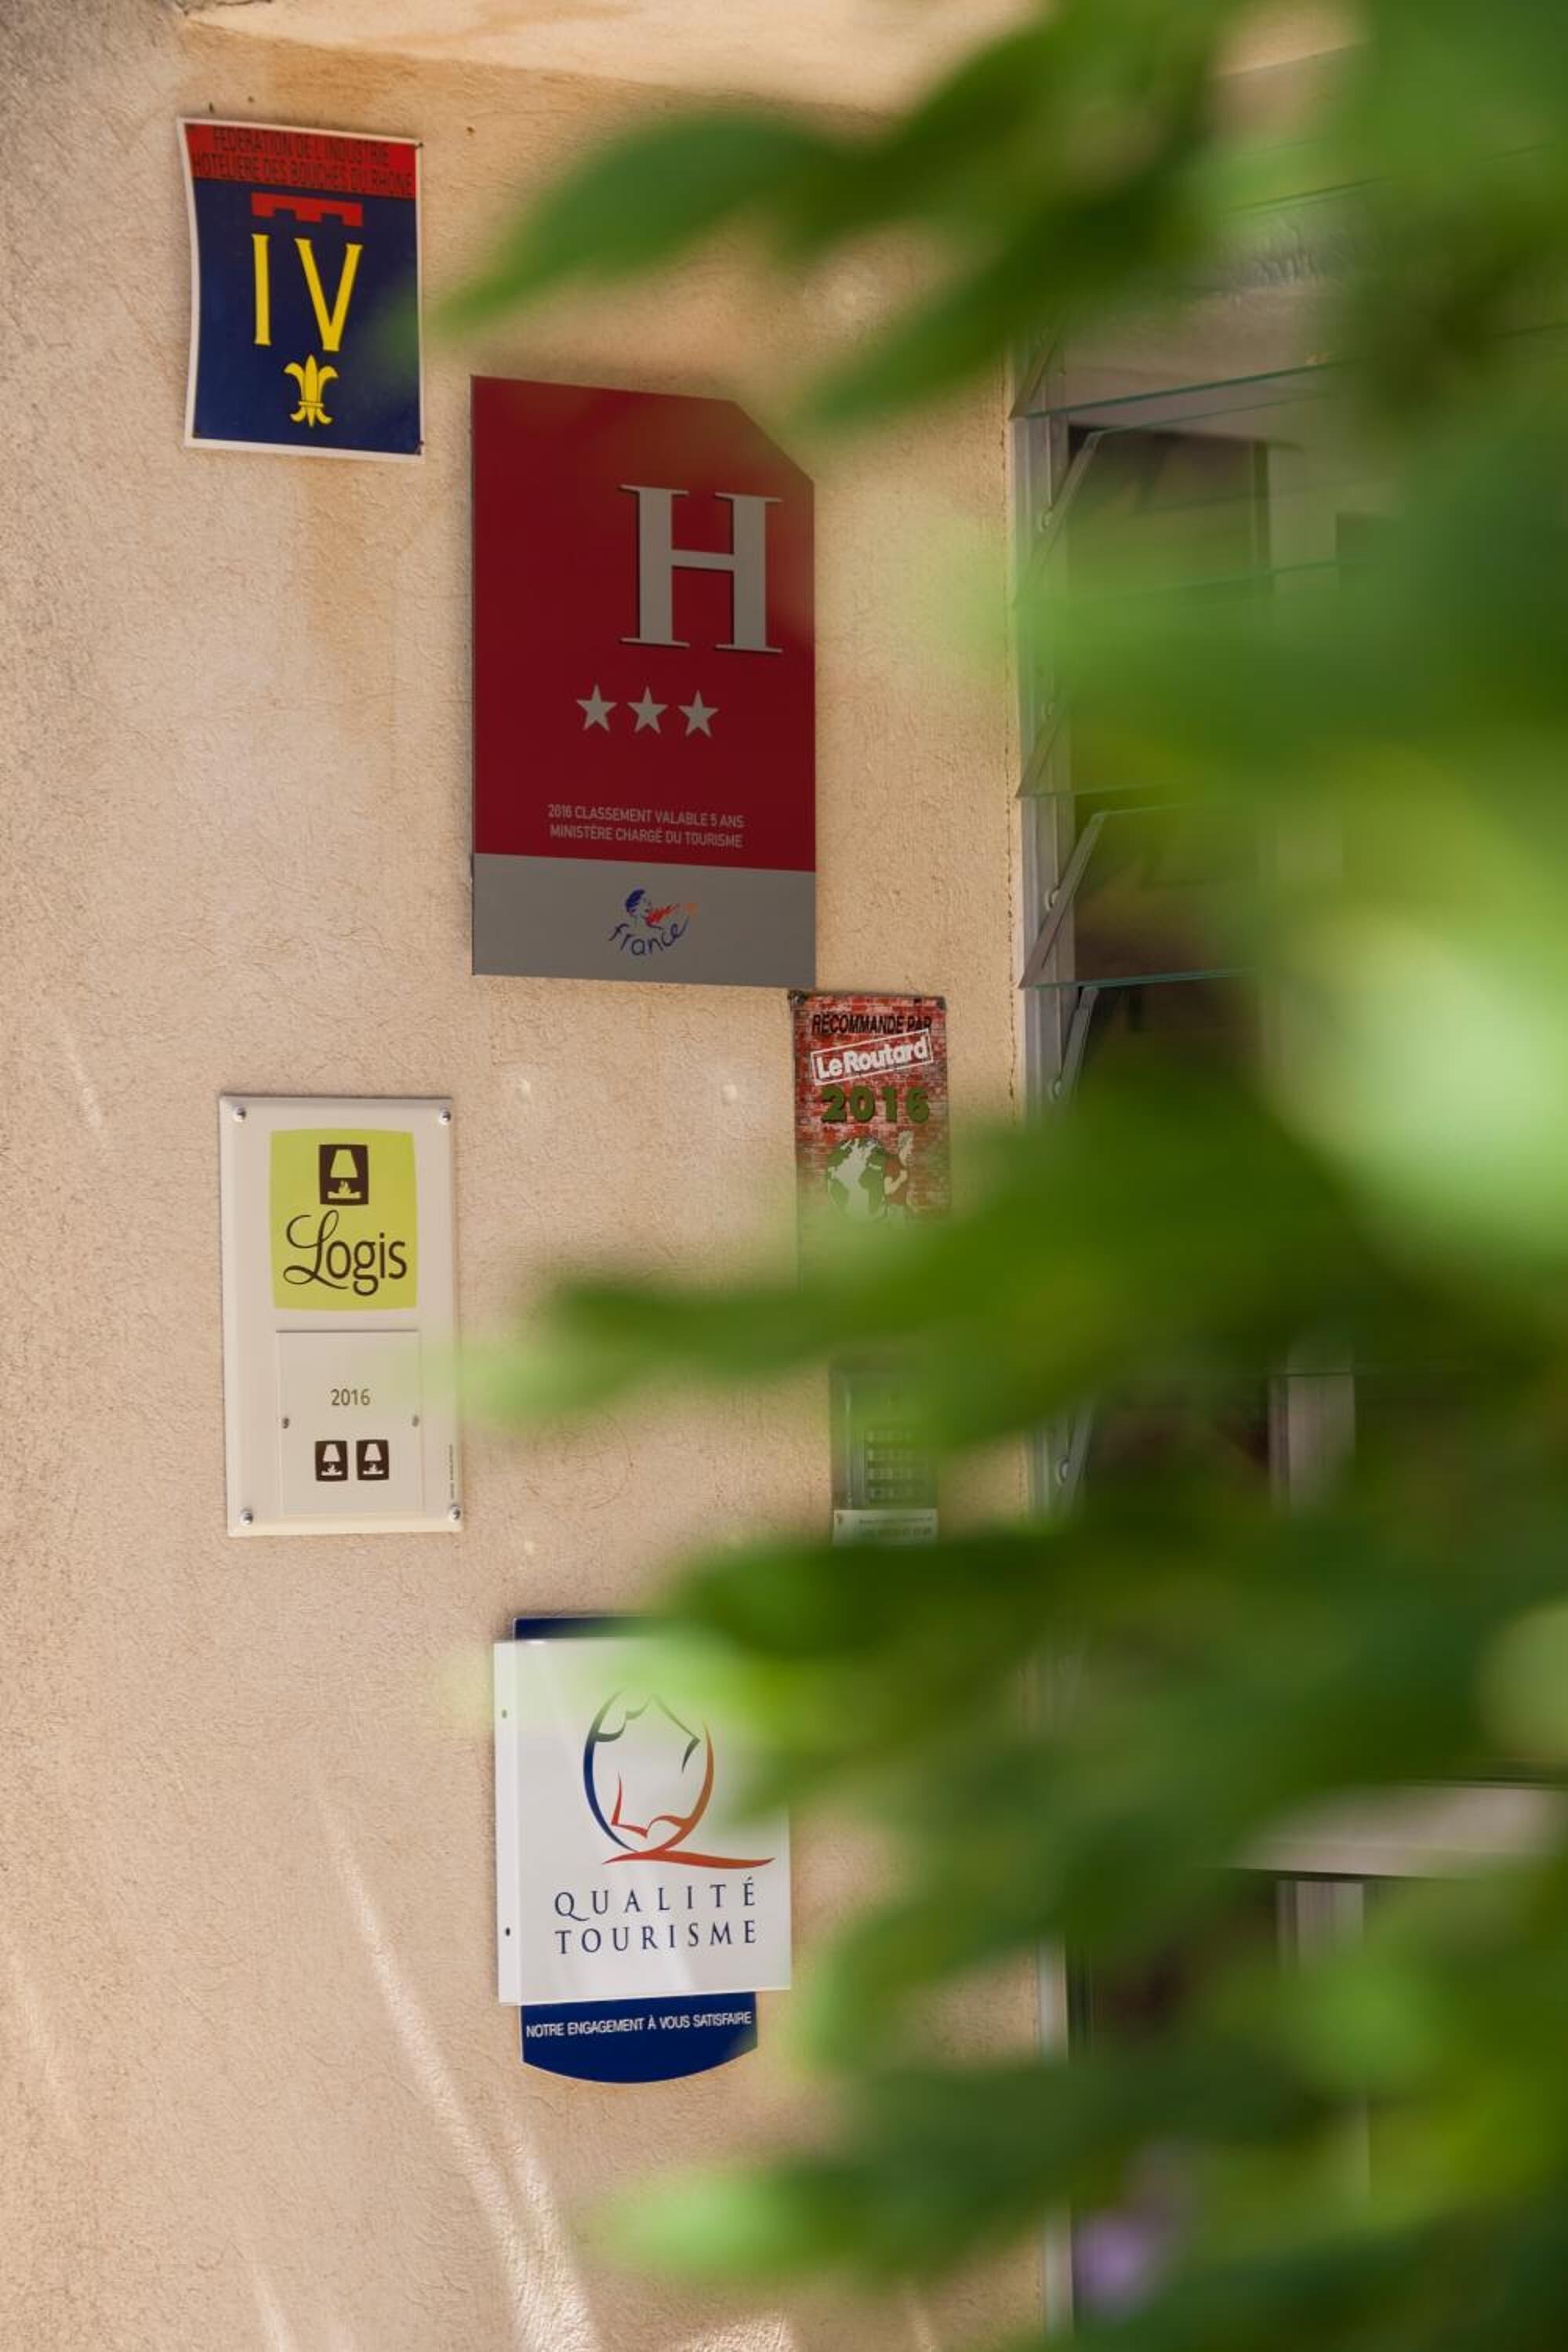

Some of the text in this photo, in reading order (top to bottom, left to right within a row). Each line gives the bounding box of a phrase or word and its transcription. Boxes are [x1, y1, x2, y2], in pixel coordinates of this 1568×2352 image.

[620, 484, 782, 653] H
[575, 805, 652, 823] CLASSEMENT
[655, 809, 707, 826] VALABLE
[710, 812, 717, 826] 5
[719, 815, 745, 829] ANS
[665, 830, 681, 844] DU
[684, 831, 743, 848] TOURISME
[907, 1015, 932, 1033] PAR
[822, 1085, 930, 1123] 2016
[283, 1210, 408, 1297] Logis
[329, 1388, 372, 1406] 2016
[554, 1876, 756, 1922] QUALITÉ
[554, 1919, 757, 1955] TOURISME
[526, 2011, 753, 2038] NOTRE ENGAGEMENT À VOUS SATISFAIRE
